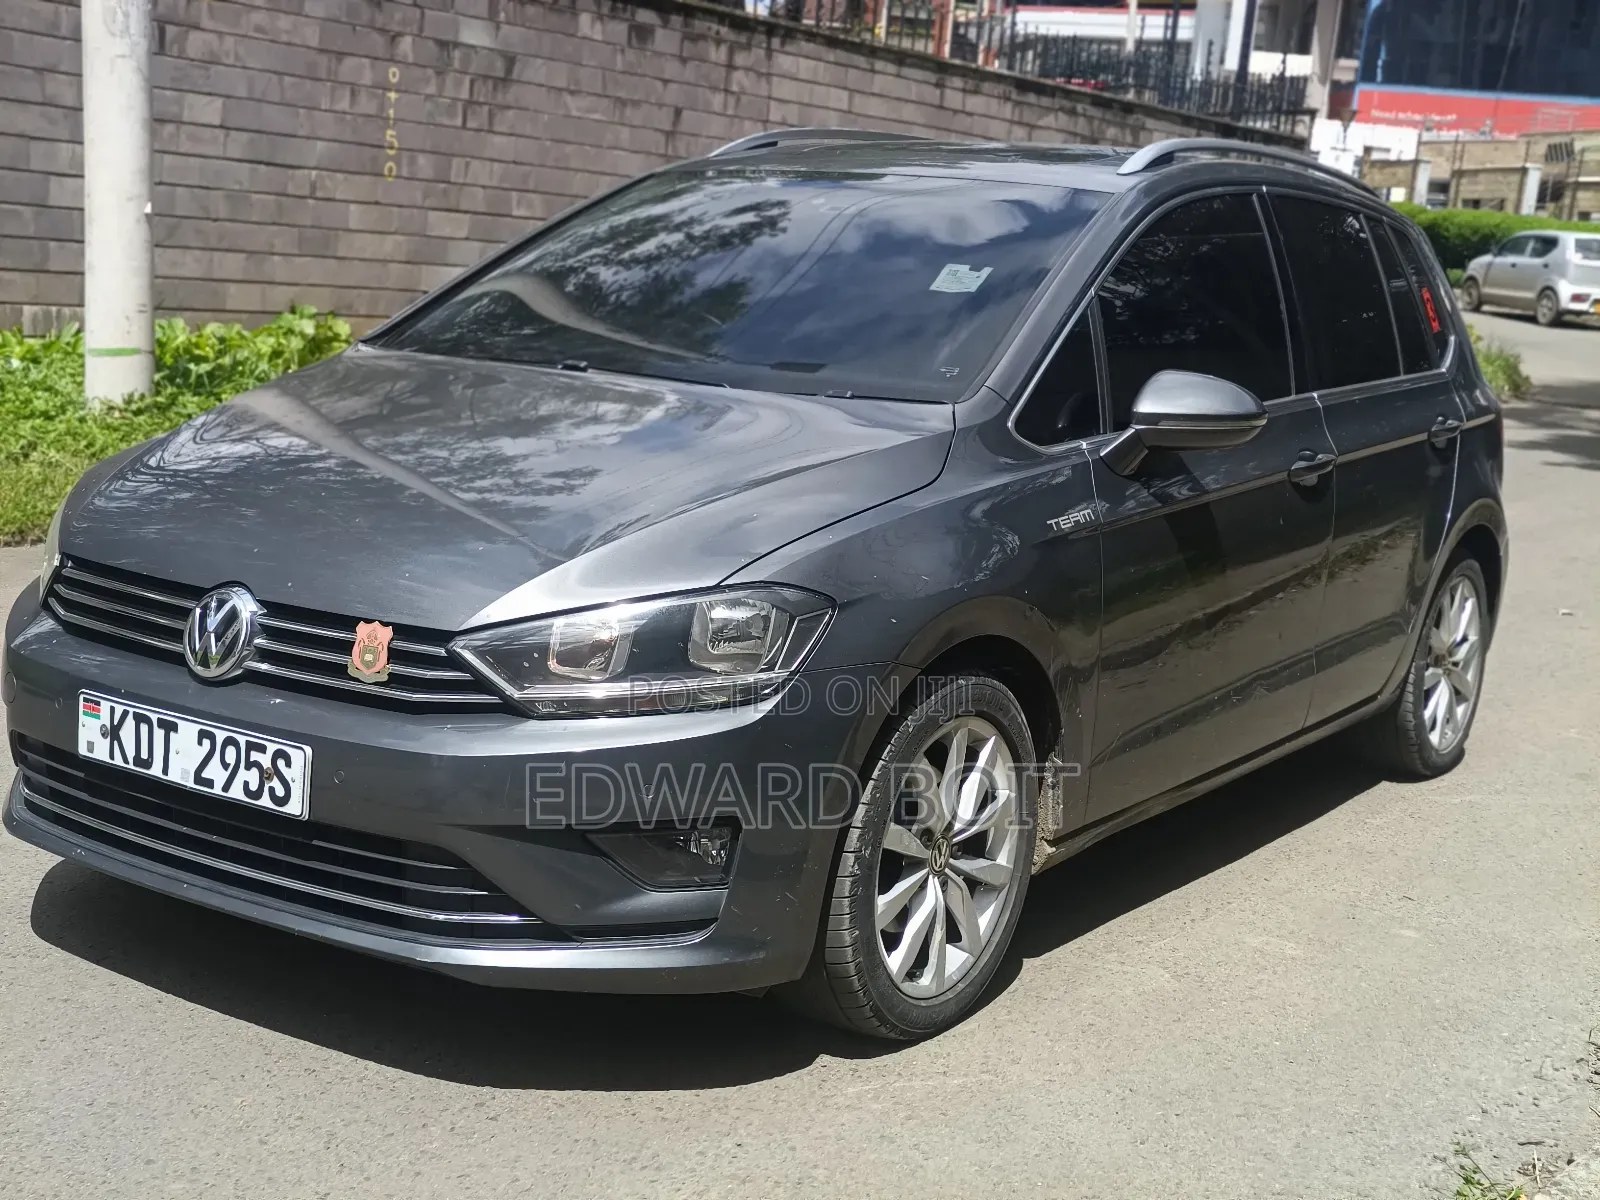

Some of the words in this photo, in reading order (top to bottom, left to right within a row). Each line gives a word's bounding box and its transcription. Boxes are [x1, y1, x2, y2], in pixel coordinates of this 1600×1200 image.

[1047, 509, 1094, 531] TEAM
[108, 705, 179, 777] KDT
[192, 728, 293, 808] 295S
